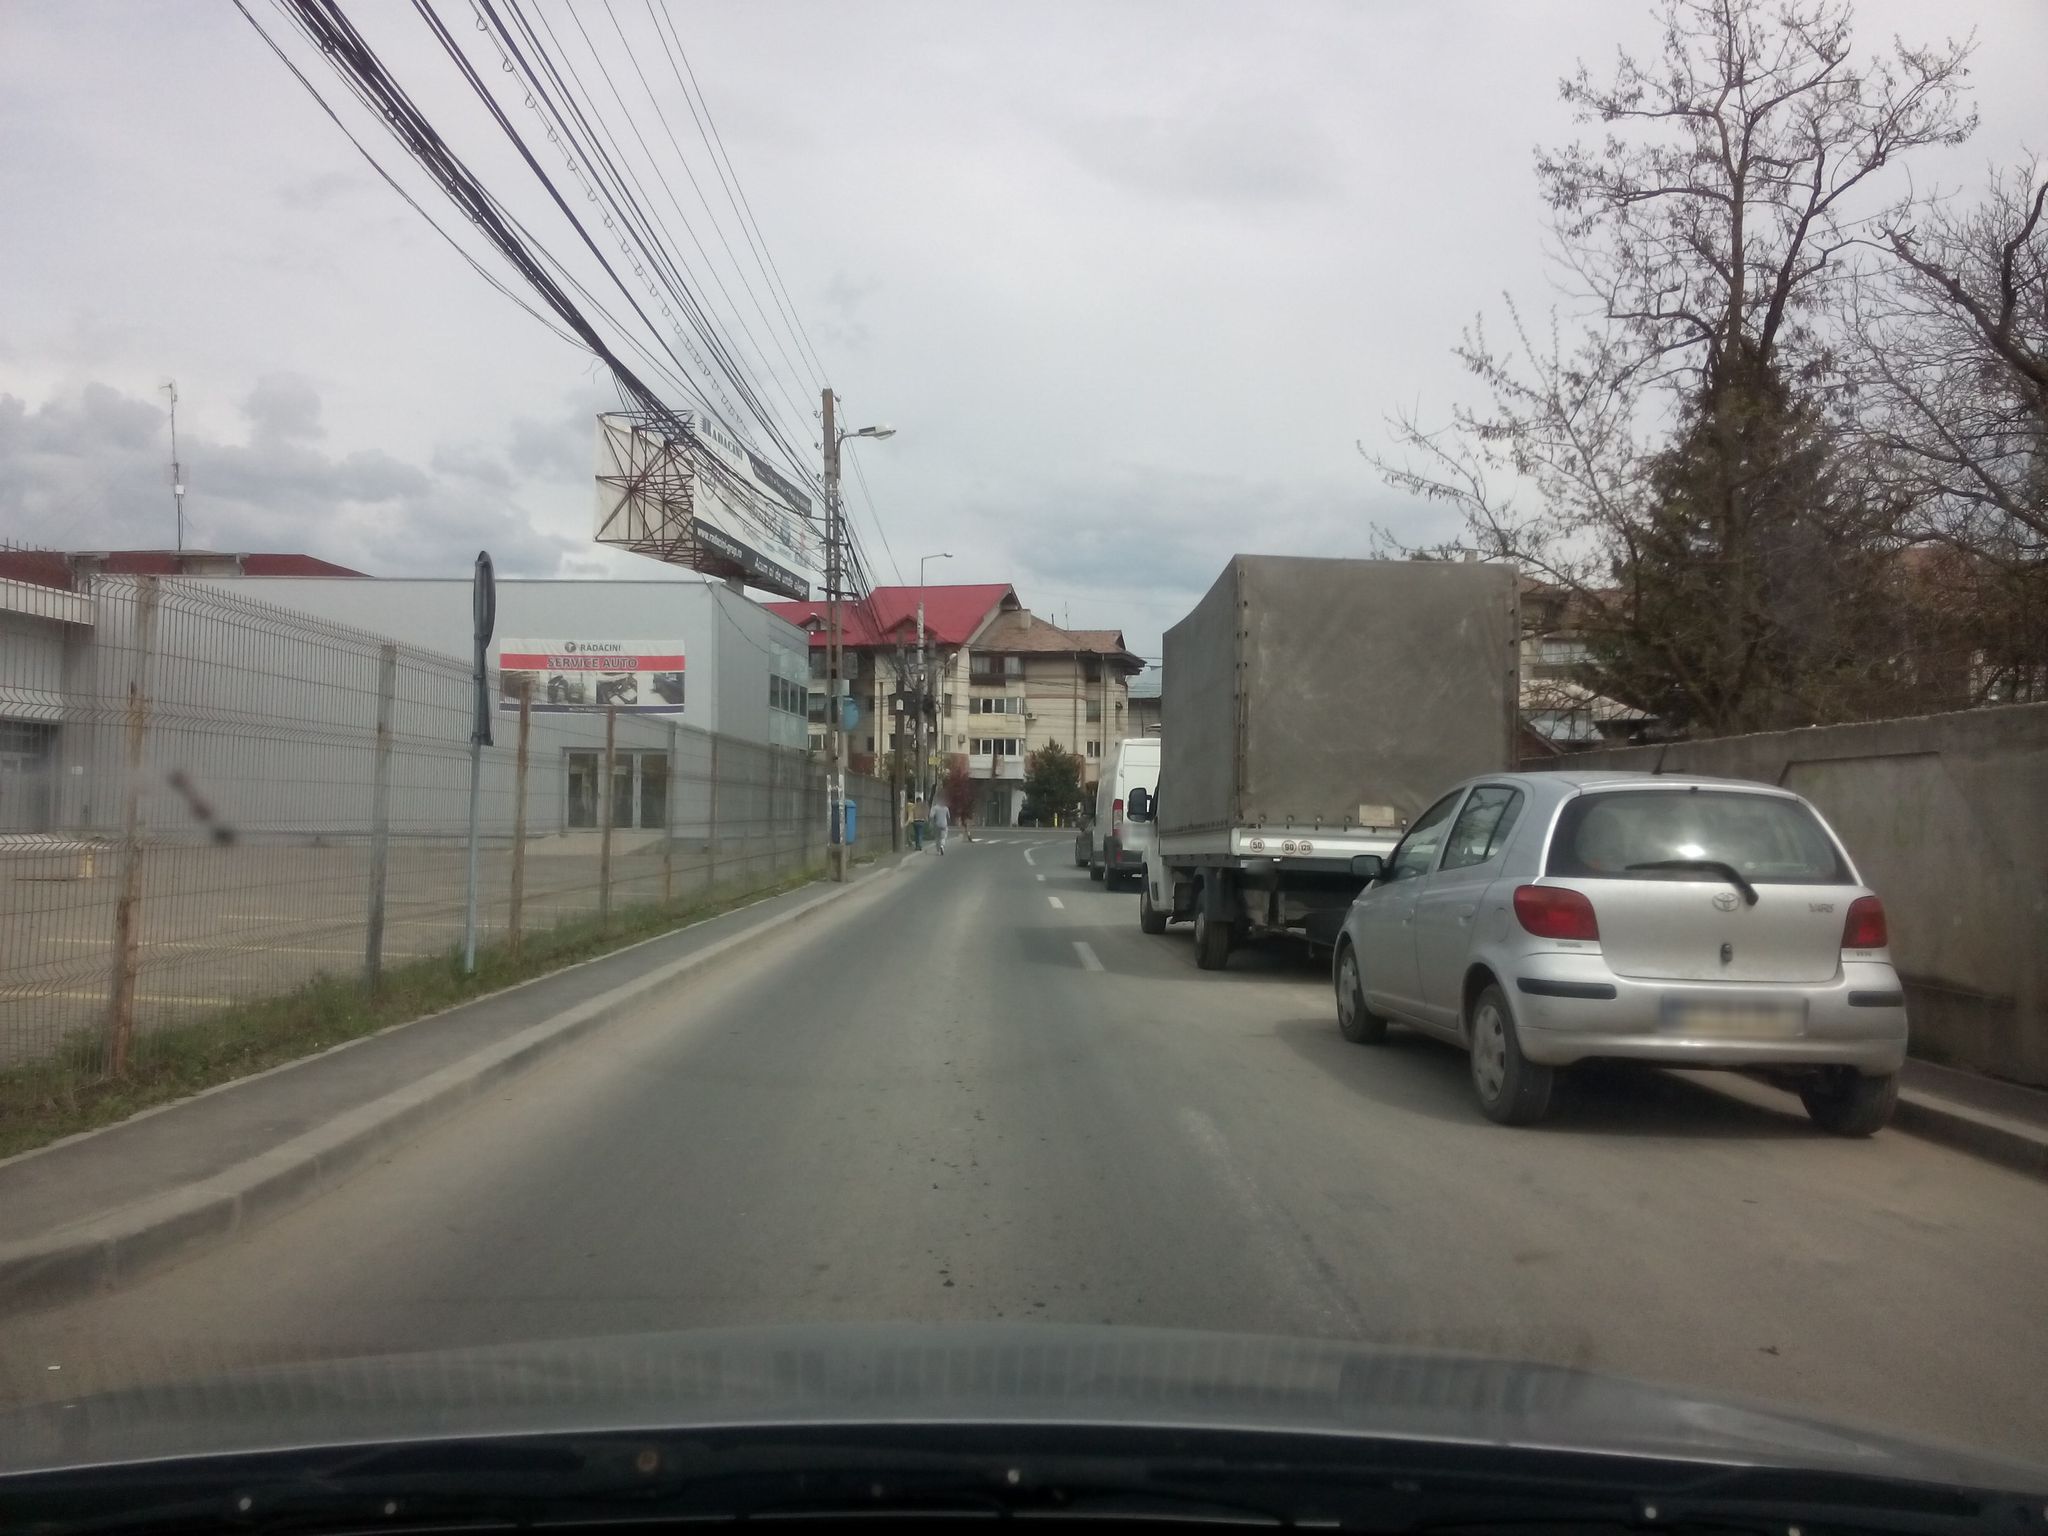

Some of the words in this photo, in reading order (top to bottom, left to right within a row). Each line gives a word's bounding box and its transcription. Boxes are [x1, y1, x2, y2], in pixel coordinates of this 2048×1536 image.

[580, 643, 621, 653] RADACINI
[547, 657, 599, 669] SERVICE
[603, 657, 638, 669] AUTO
[1252, 842, 1263, 850] 50
[1284, 843, 1295, 851] 90
